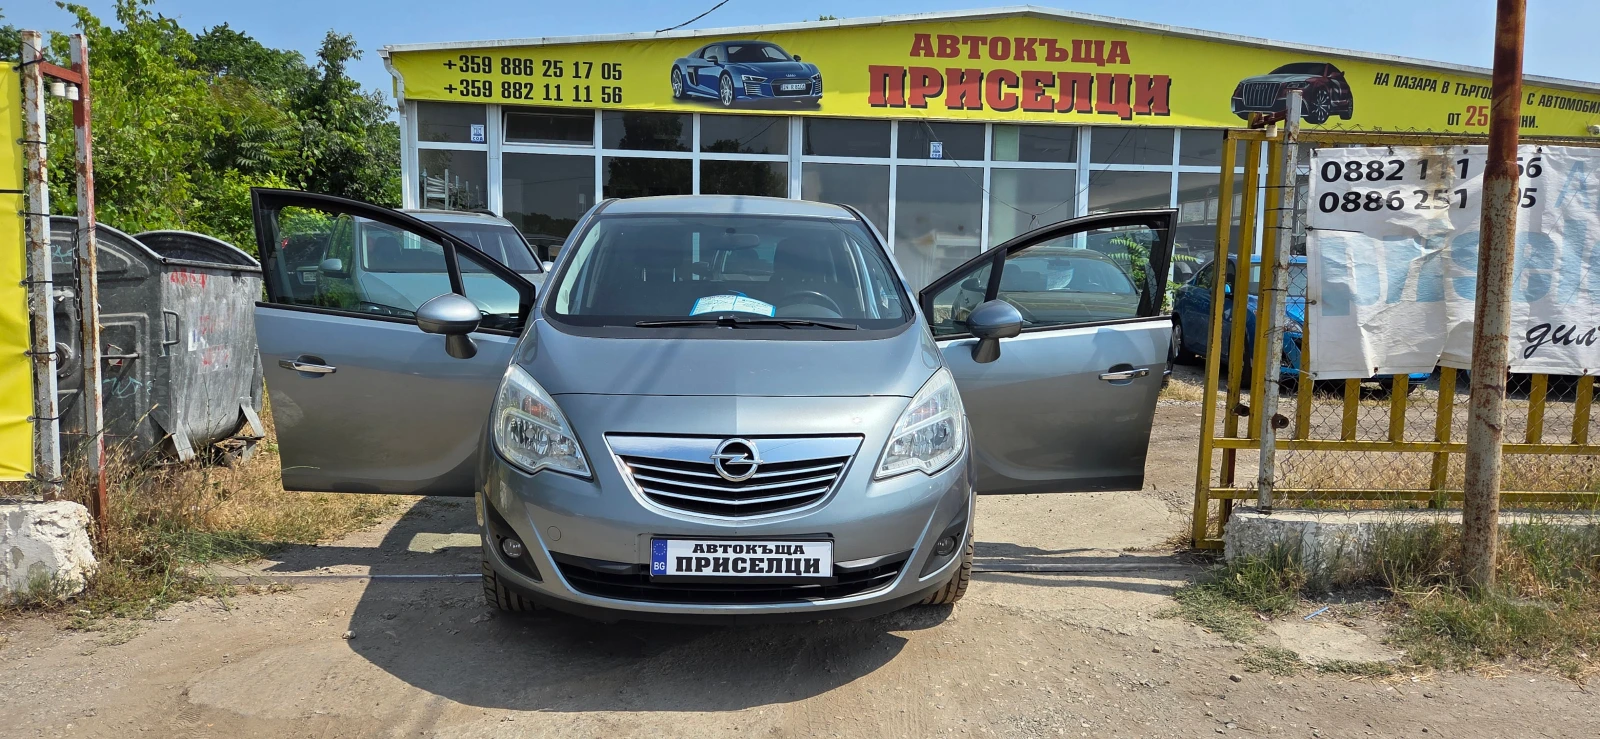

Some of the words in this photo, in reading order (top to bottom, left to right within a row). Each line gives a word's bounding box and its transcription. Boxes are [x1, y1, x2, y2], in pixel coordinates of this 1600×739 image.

[909, 33, 1131, 67] АВТОКЪЩА
[443, 55, 492, 74] +359
[500, 57, 534, 77] 886
[542, 59, 564, 78] 25
[572, 61, 594, 79] 17
[601, 62, 622, 81] 05
[443, 79, 492, 98] +359
[500, 81, 534, 100] 882
[542, 84, 564, 102] 11
[572, 85, 593, 103] 11
[601, 86, 622, 104] 56
[868, 65, 1171, 120] ПРИСЕЛЦИ
[1374, 72, 1389, 87] НА
[1394, 75, 1437, 92] ПАЗАРА
[1441, 81, 1450, 94] В
[1526, 92, 1536, 105] С
[1447, 113, 1462, 126] ОТ
[1465, 105, 1489, 127] 25
[1321, 159, 1405, 183] 0882
[1319, 190, 1405, 213] 0886
[1413, 188, 1468, 210] 251
[692, 543, 805, 555] АВТОКЪЩА
[654, 562, 665, 571] BG
[676, 557, 820, 575] ПРИСЕЛЦИ
